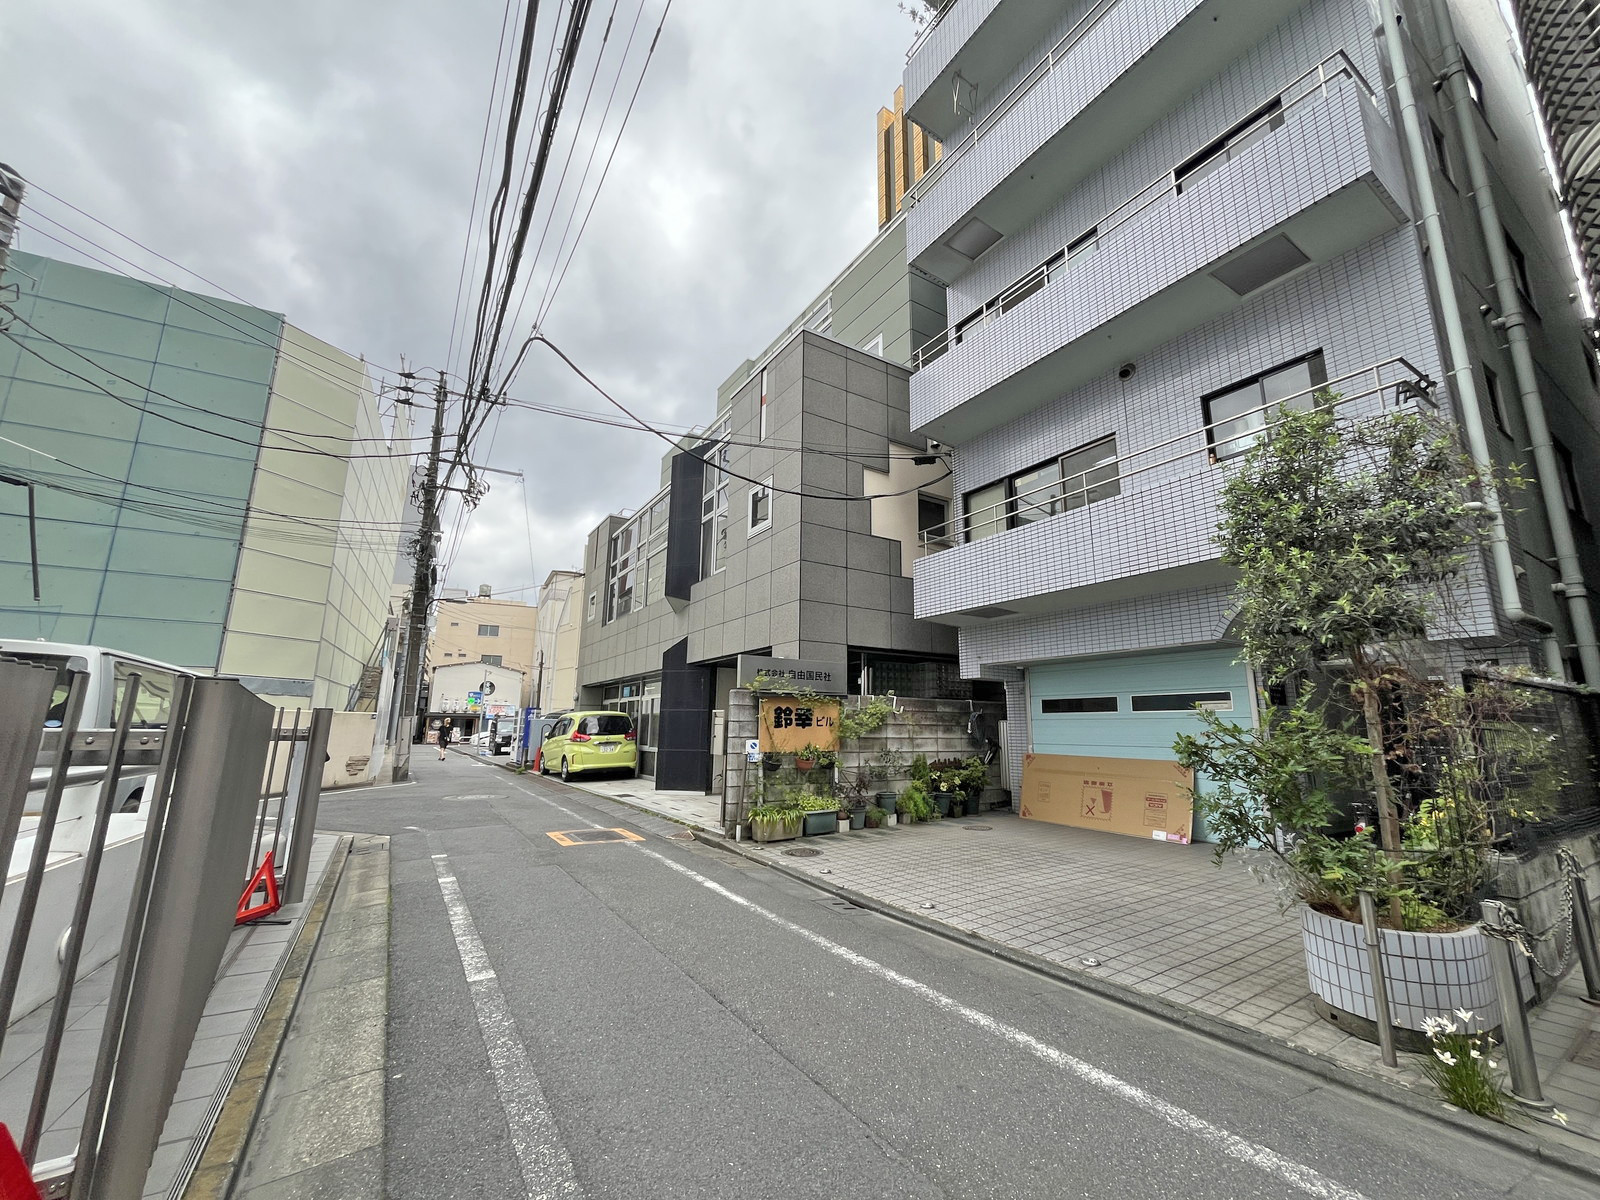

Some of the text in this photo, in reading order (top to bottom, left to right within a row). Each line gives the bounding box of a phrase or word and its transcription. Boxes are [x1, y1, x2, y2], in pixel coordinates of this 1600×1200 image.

[788, 669, 832, 682] 自由国民社
